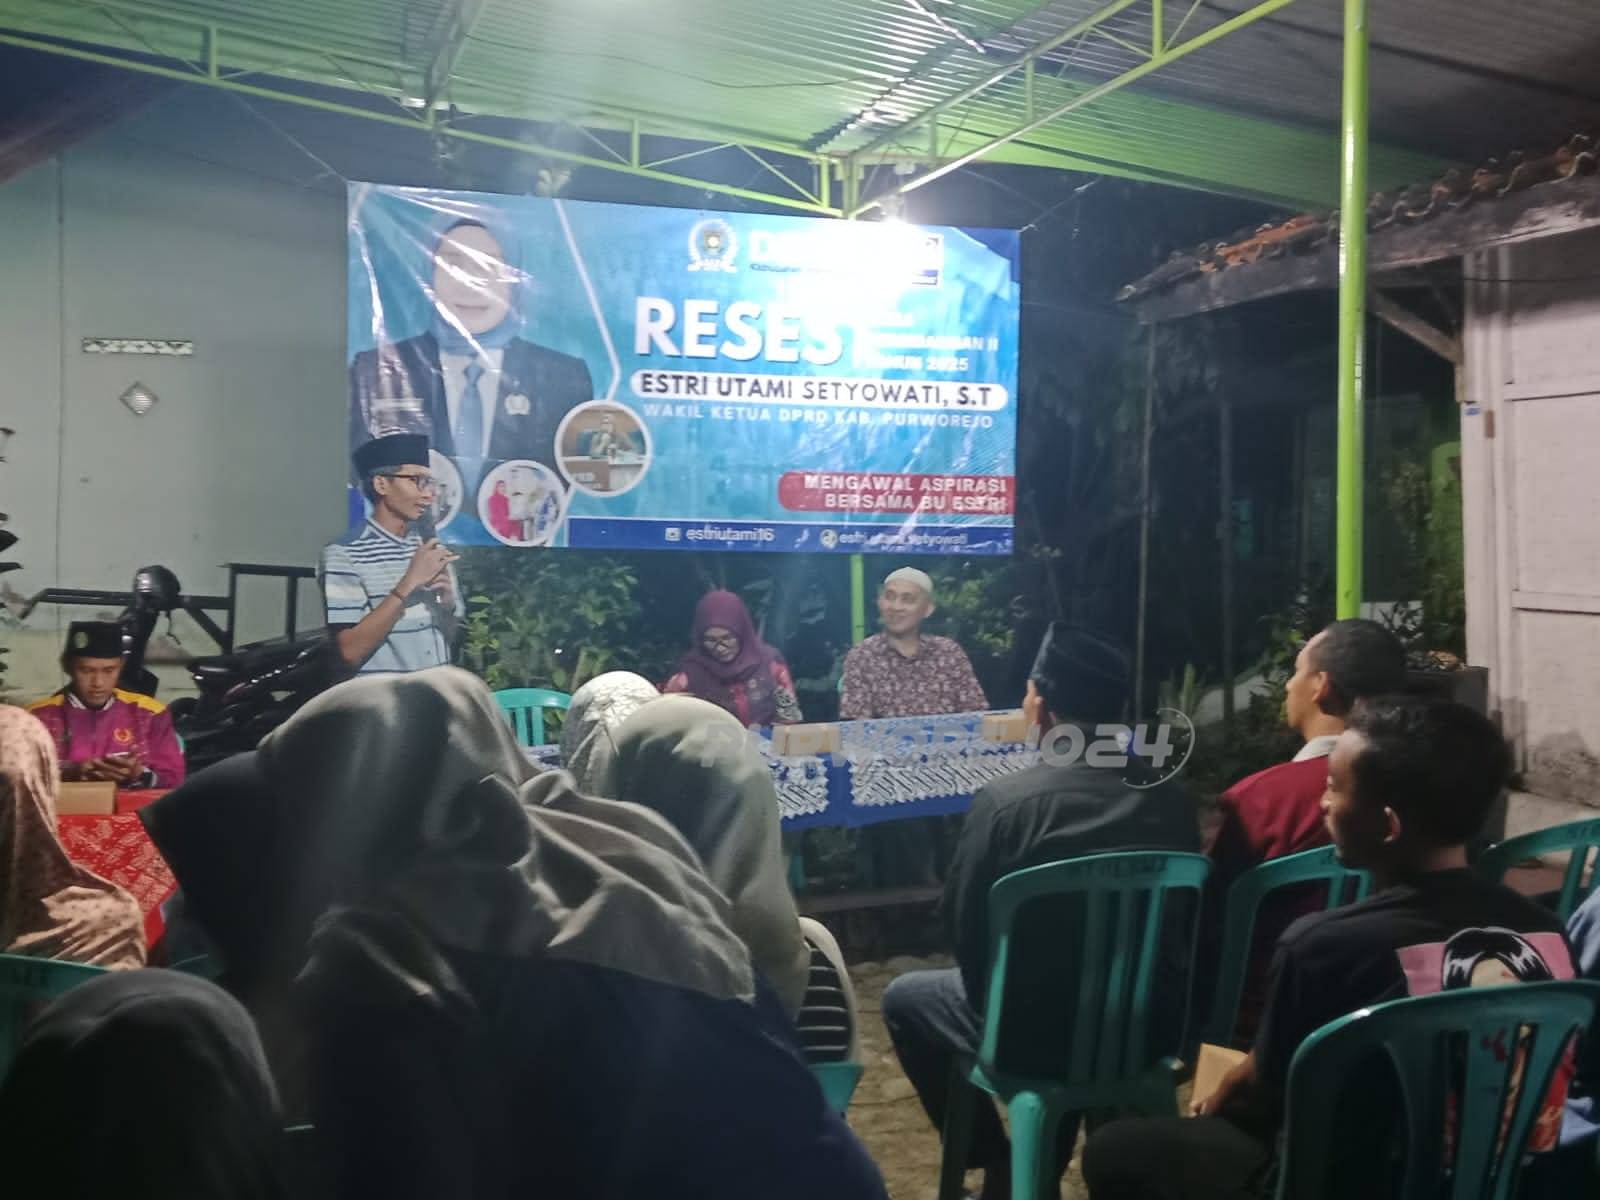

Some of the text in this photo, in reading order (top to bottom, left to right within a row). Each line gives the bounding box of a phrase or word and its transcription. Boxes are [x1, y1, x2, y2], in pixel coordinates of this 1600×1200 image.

[634, 297, 844, 366] RESES
[641, 373, 992, 407] ESTRI UTAMI SETYOWATI, S.T
[644, 403, 704, 418] WAKIL
[711, 407, 770, 420] KETUA
[779, 408, 828, 424] DPRD
[882, 412, 994, 429] PURWOREJO
[804, 474, 1007, 492] MENGAWAL ASPIRASI
[825, 494, 913, 508] BERSAMA
[922, 495, 945, 509] BU
